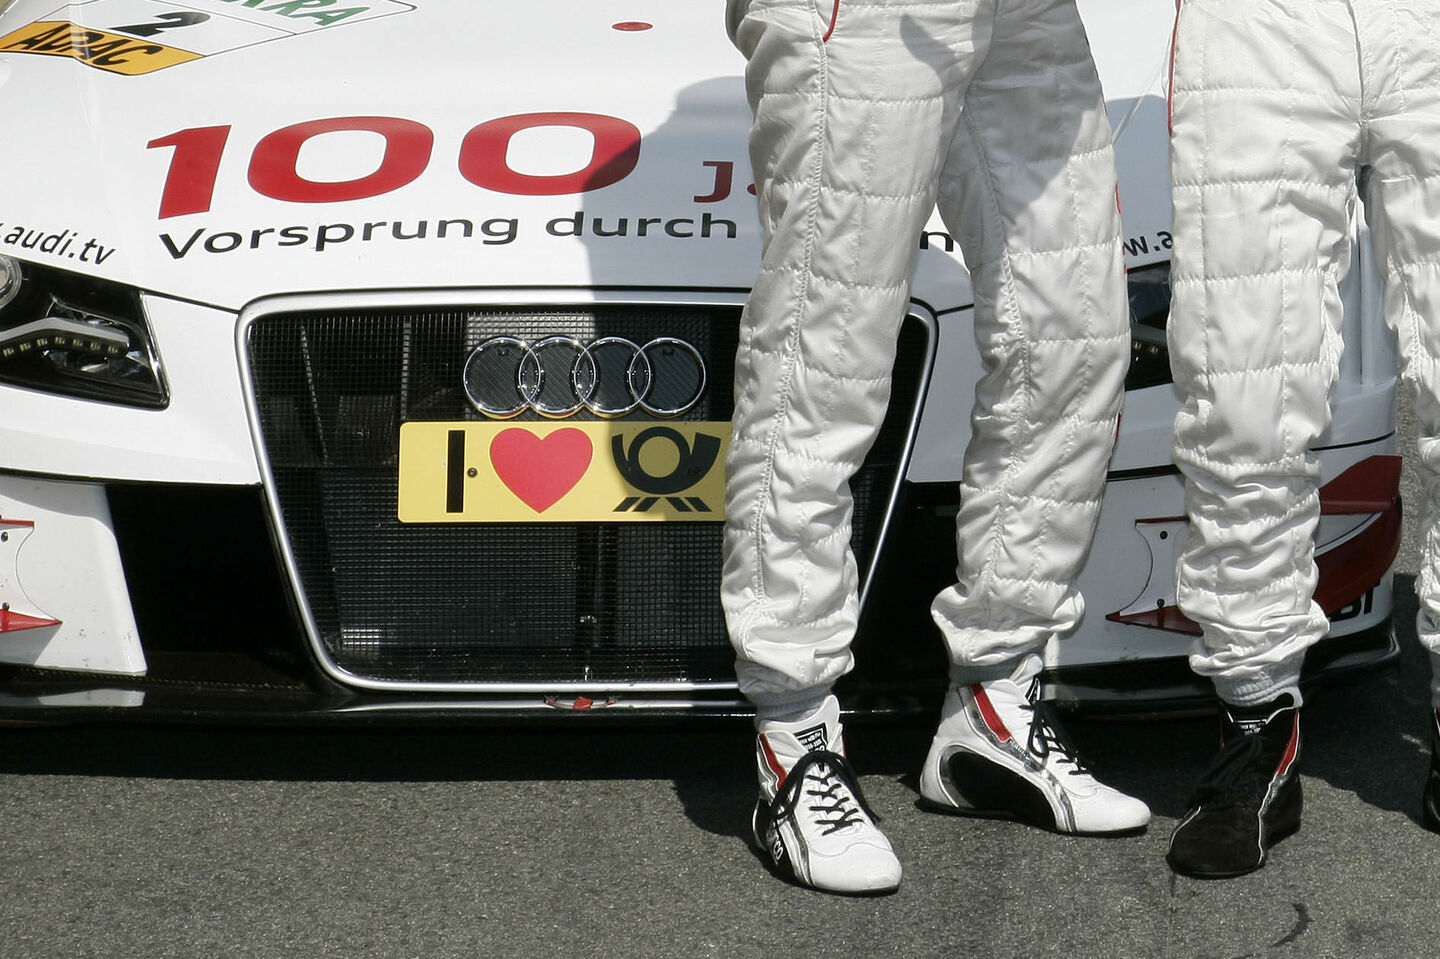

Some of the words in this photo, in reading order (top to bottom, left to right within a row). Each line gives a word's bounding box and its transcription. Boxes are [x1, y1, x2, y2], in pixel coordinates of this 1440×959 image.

[11, 22, 164, 66] ADAC
[108, 11, 211, 38] 2
[146, 112, 642, 220] 100
[0, 222, 116, 266] .audi.tv
[159, 214, 520, 260] Vorsprung
[545, 211, 737, 239] durch
[446, 429, 467, 514] I
